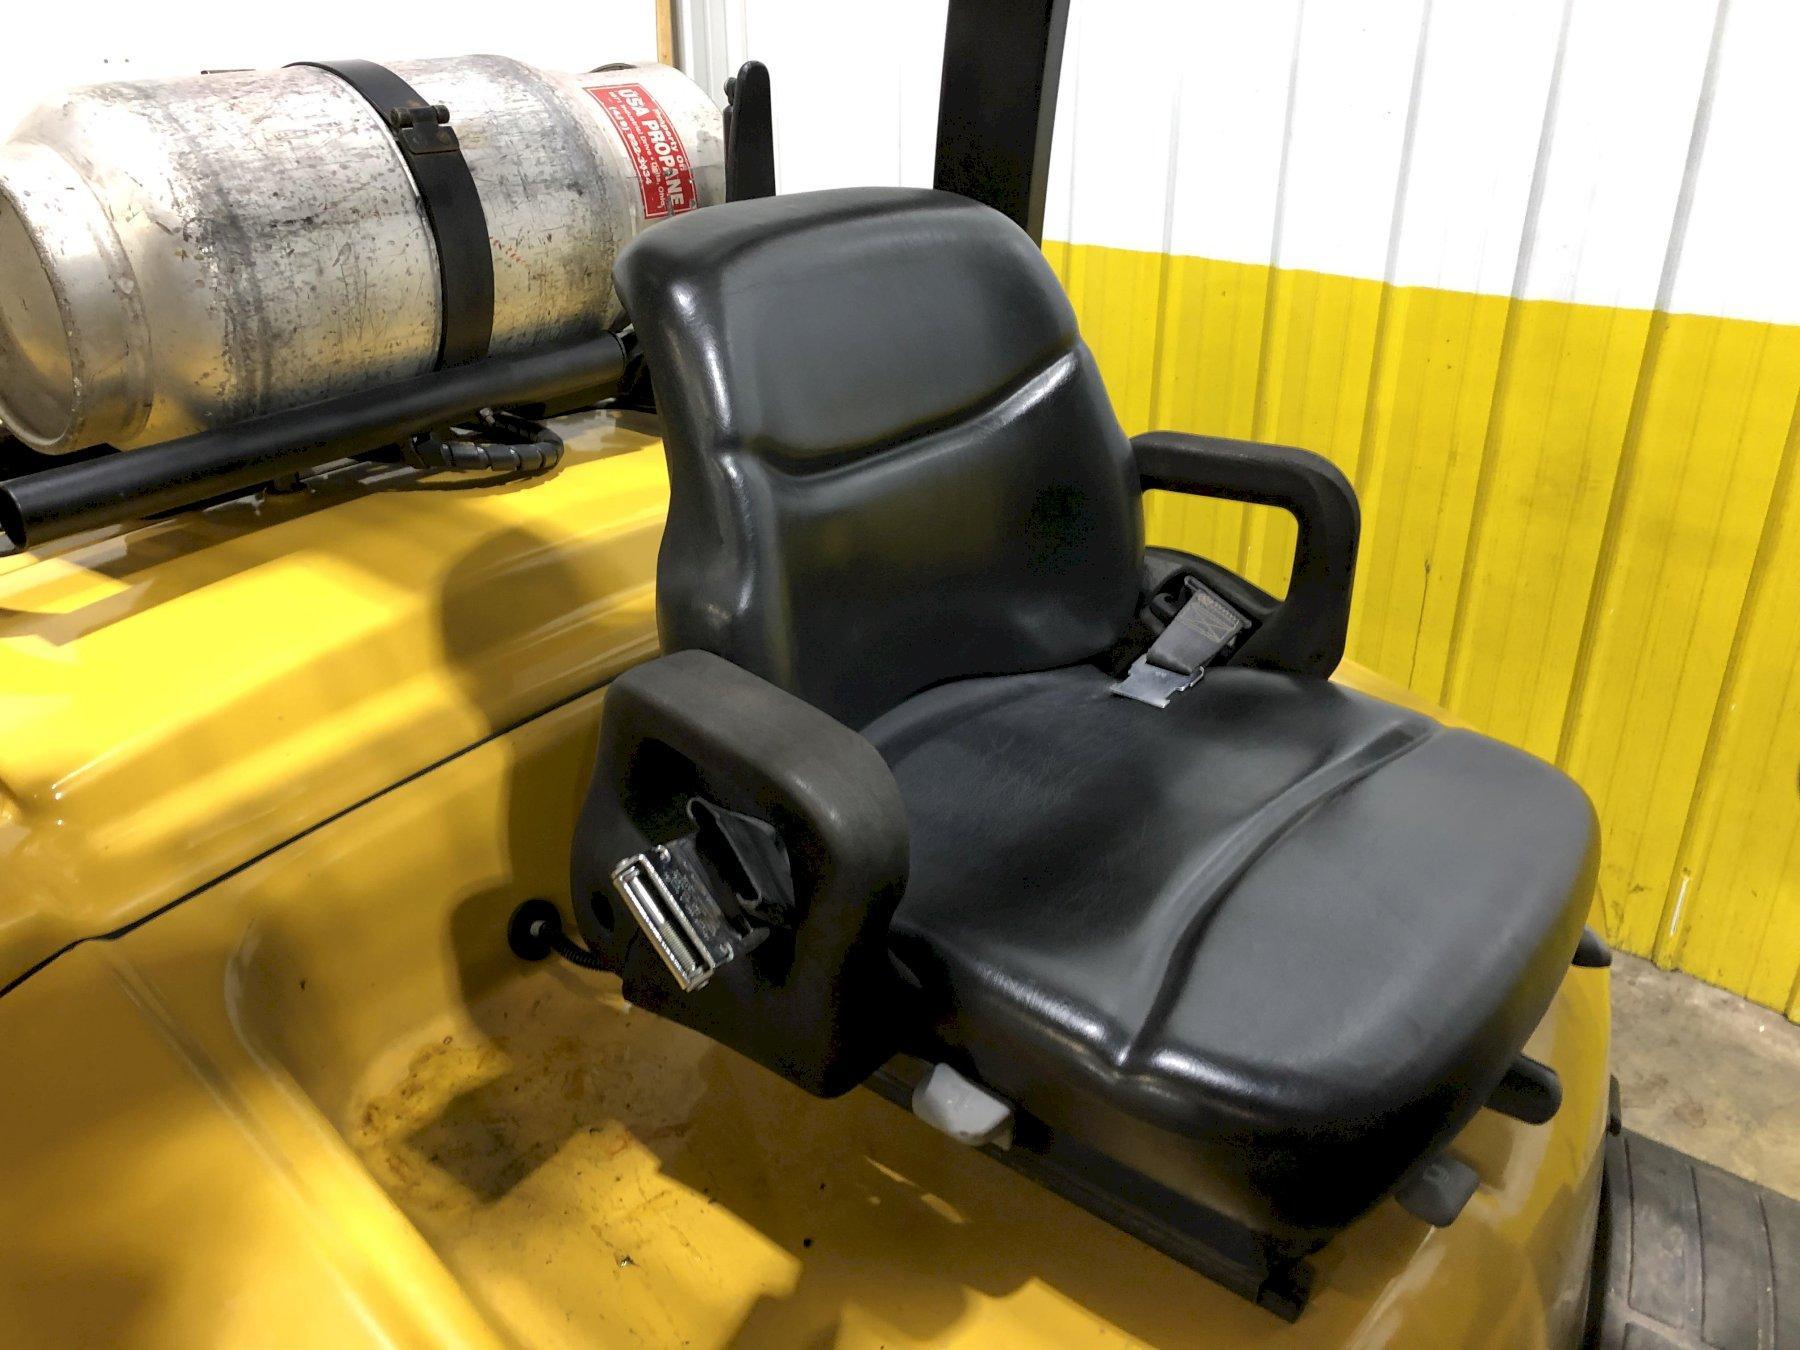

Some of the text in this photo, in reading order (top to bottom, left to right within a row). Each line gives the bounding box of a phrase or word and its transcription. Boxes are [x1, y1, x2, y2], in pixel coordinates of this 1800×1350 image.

[618, 88, 685, 206] USA PROPANE
[641, 135, 652, 156] Drive
